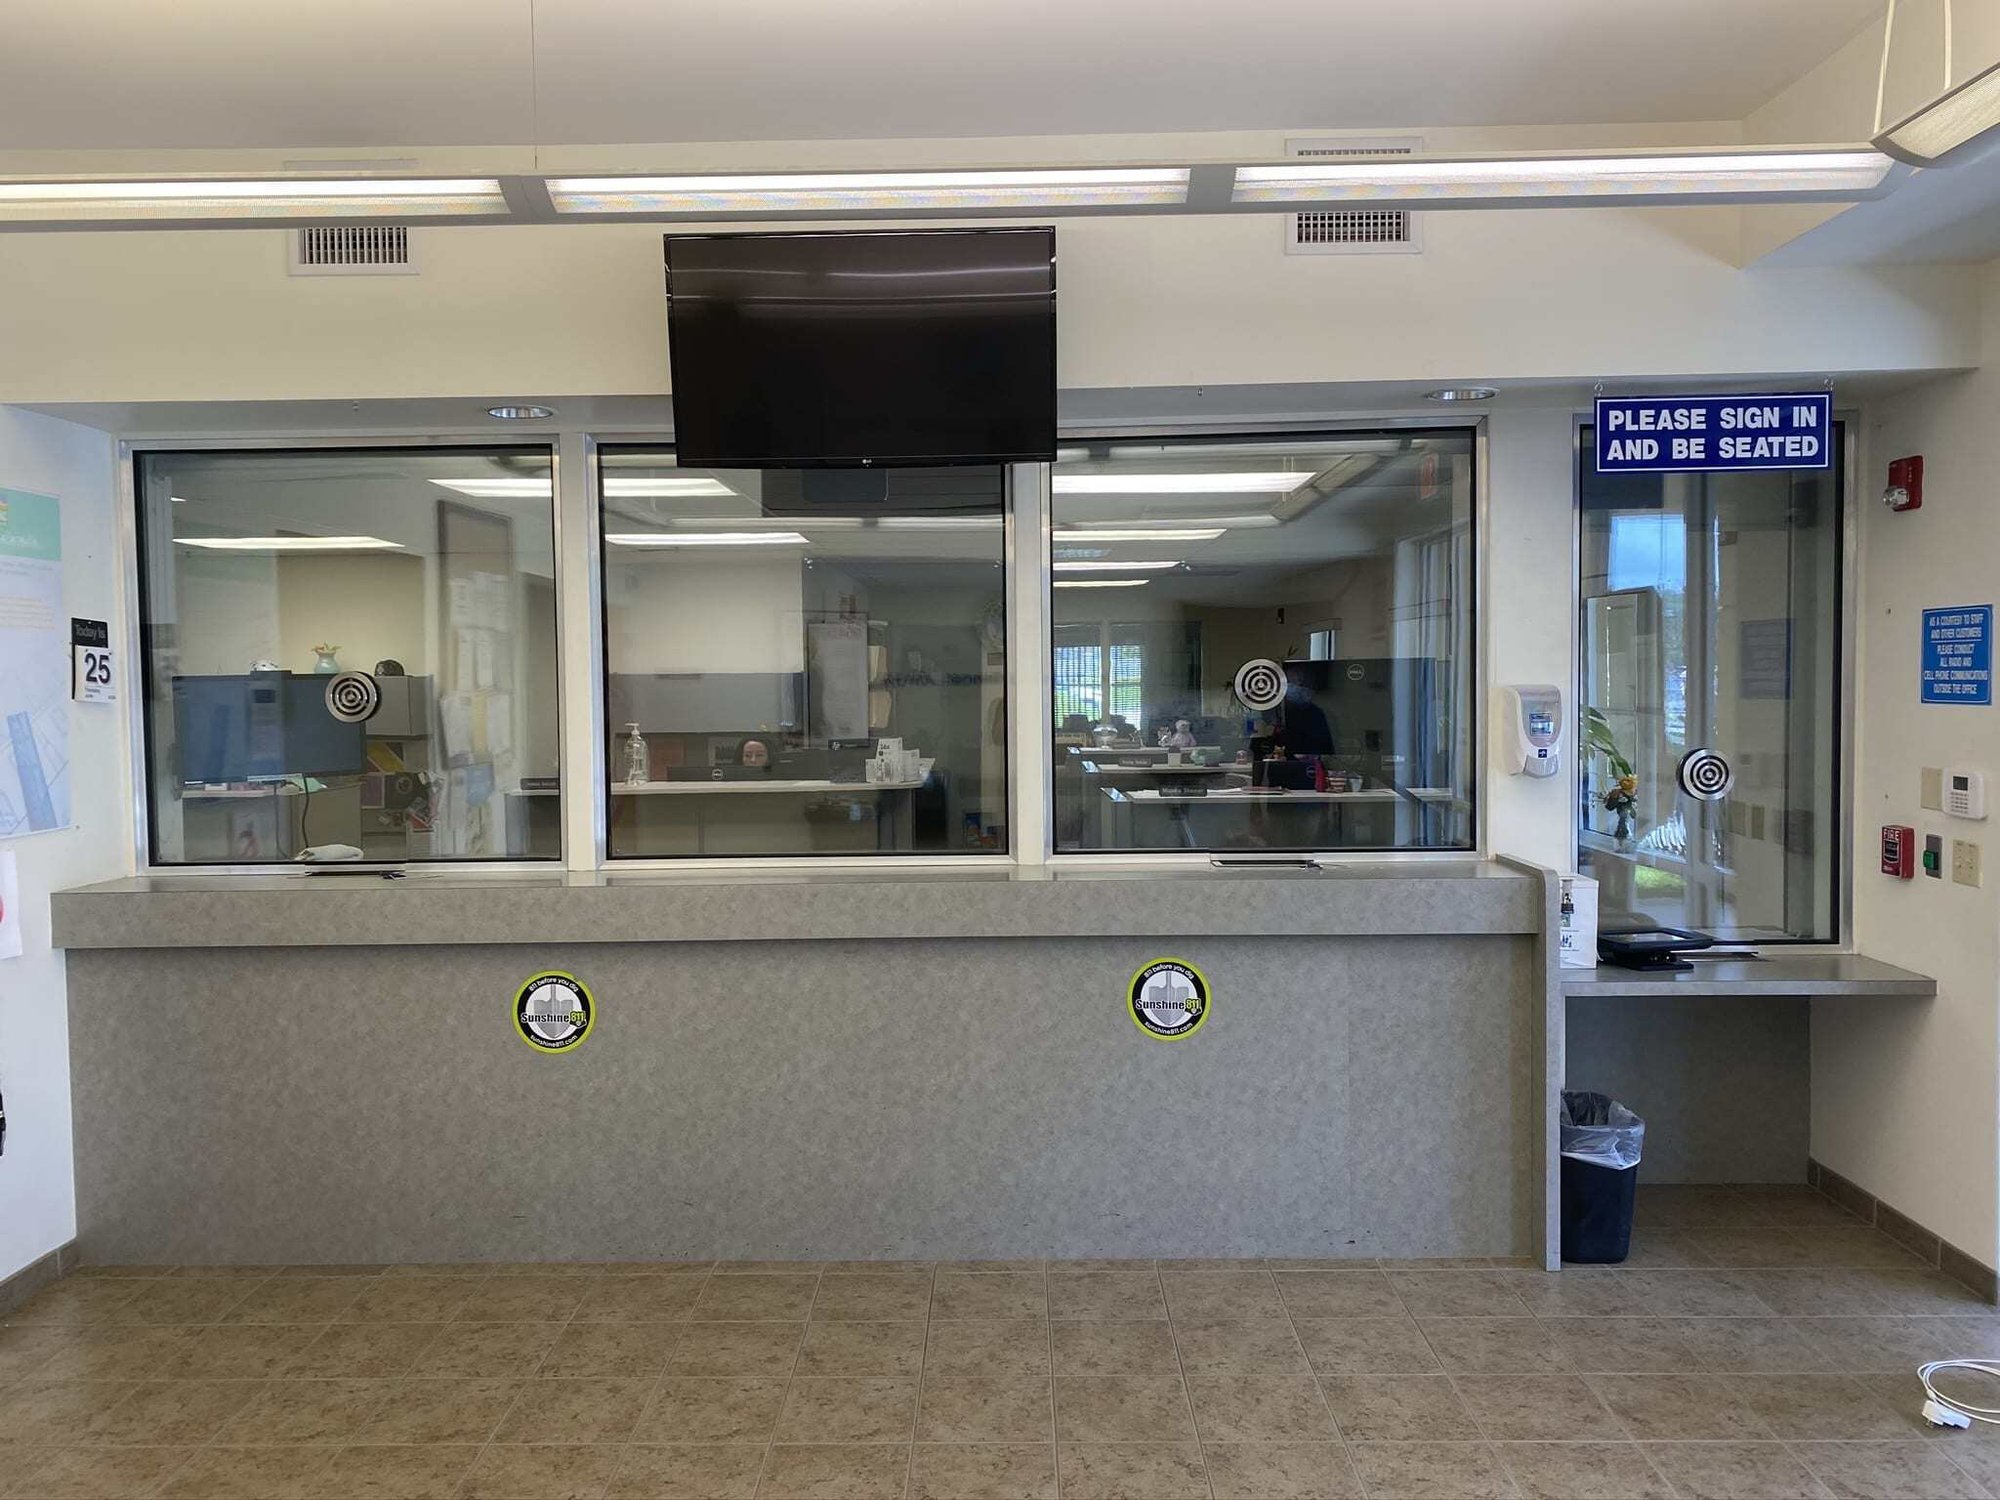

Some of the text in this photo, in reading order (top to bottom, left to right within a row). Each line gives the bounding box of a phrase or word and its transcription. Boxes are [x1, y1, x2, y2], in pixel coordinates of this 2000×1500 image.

[1608, 406, 1817, 431] PLEASE SIGN IN
[1607, 436, 1819, 460] AND BE SEATED
[75, 624, 97, 640] Today
[1931, 629, 1940, 639] AND
[1937, 644, 1953, 655] PLEASE
[85, 653, 111, 684] 25
[1883, 828, 1900, 840] FIRE
[1153, 964, 1172, 973] before
[1173, 965, 1184, 973] you
[1184, 969, 1194, 980] dig
[538, 977, 557, 986] before
[558, 978, 569, 986] you
[569, 983, 579, 992] dig
[1144, 1021, 1193, 1034] sunshine811.com
[530, 1035, 578, 1047] sunshine811.com
